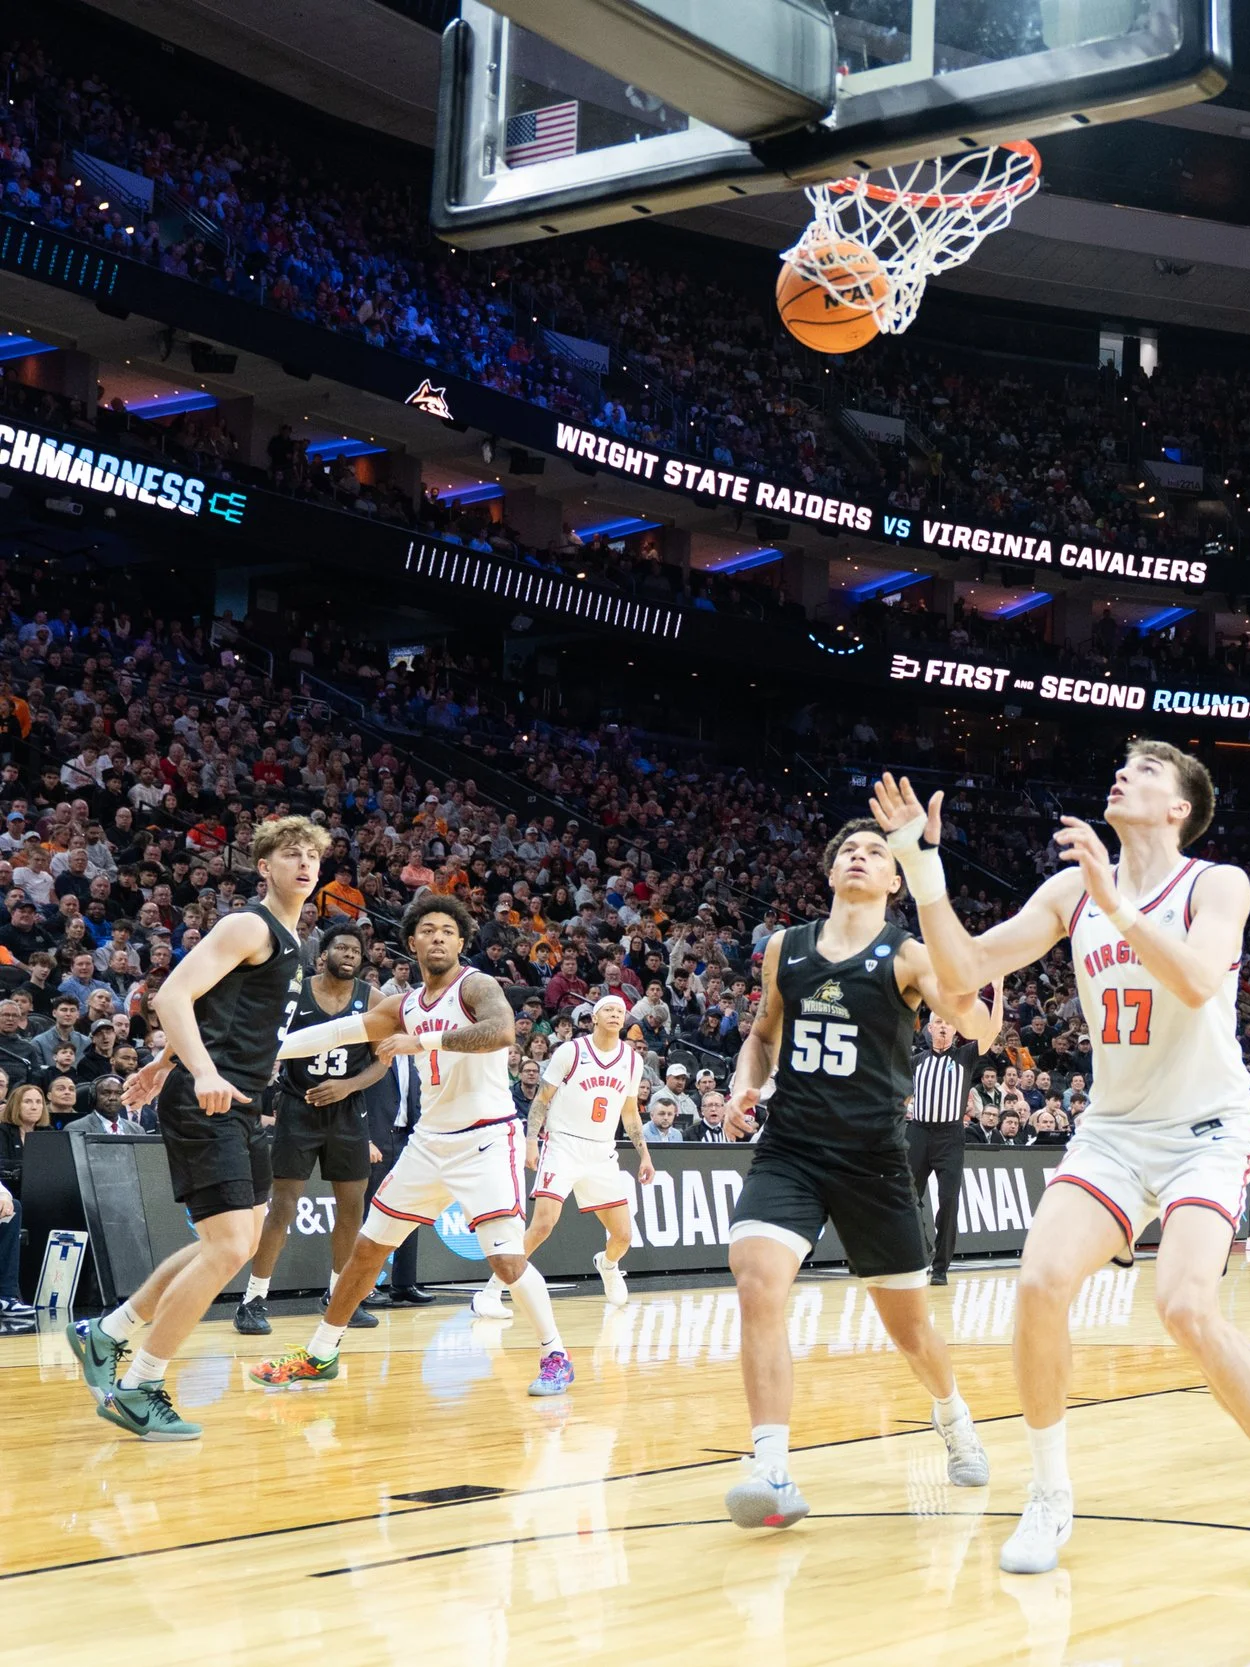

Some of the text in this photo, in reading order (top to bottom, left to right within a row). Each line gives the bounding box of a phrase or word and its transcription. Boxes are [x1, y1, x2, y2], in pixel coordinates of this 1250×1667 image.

[556, 422, 1208, 584] WRIGHT STATE RAIDERS VS VIRGINIA CAVALIERS
[924, 659, 1010, 692] FIRST
[1014, 679, 1034, 690] AND
[1040, 675, 1146, 710] SECOND
[1102, 988, 1153, 1045] 17
[307, 1047, 348, 1076] 33
[429, 1049, 441, 1086] 1
[791, 1019, 858, 1077] 55
[579, 1075, 625, 1094] VIRGINIA
[591, 1096, 608, 1122] 6
[606, 1170, 744, 1248] ROAD
